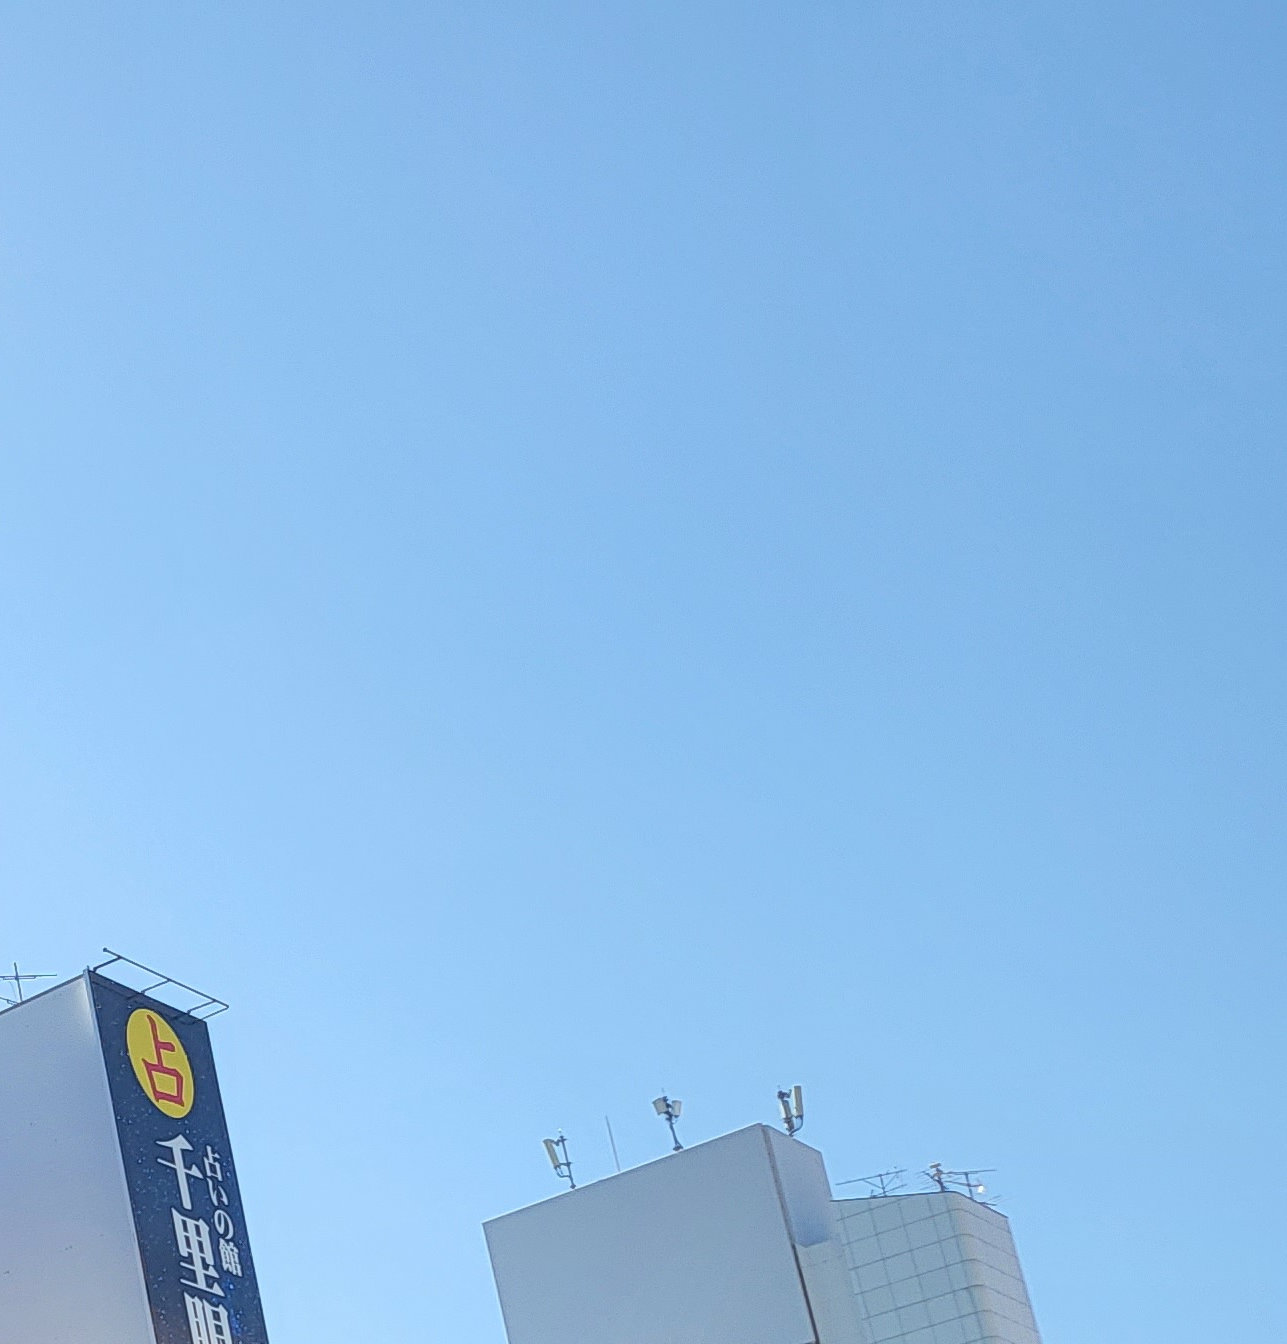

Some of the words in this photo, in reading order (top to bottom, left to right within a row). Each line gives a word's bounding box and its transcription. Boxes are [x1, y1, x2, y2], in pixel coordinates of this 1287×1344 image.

[139, 1014, 184, 1107] 占
[203, 1143, 243, 1279] 占いの館
